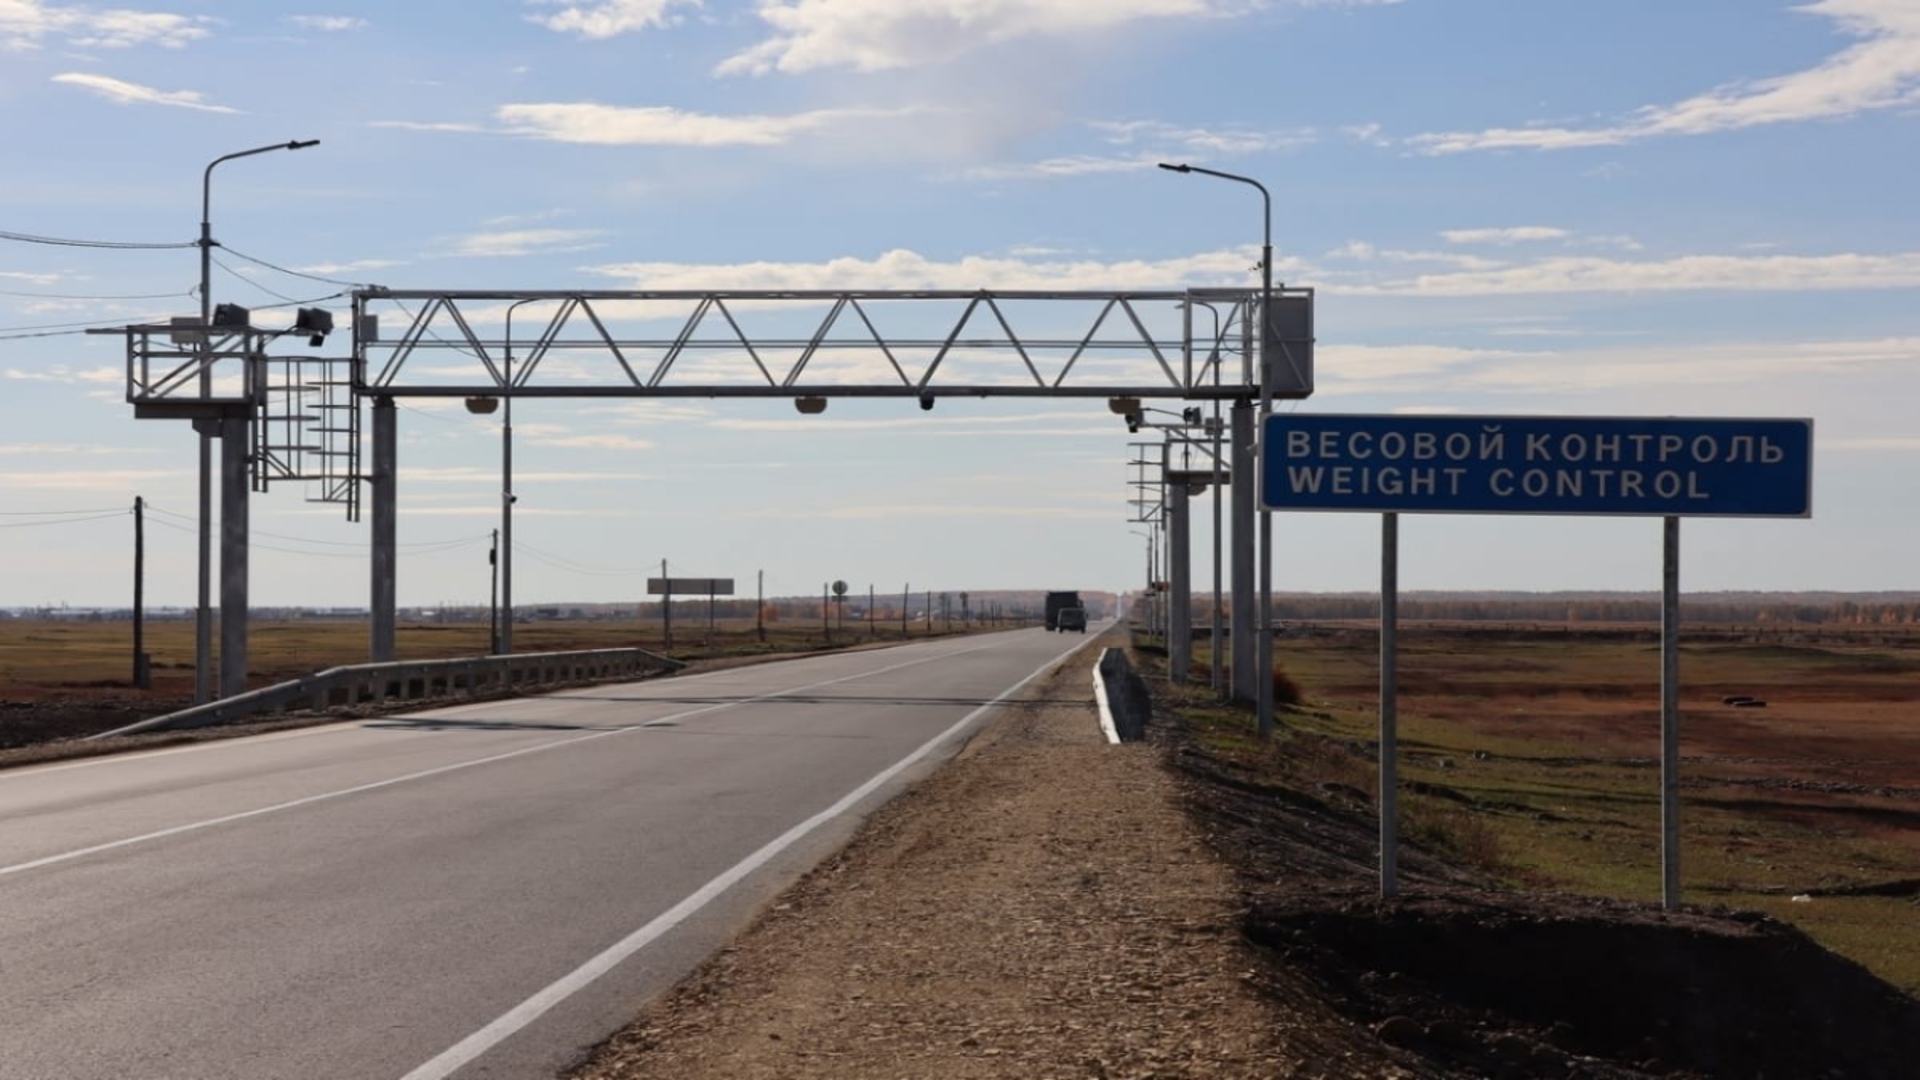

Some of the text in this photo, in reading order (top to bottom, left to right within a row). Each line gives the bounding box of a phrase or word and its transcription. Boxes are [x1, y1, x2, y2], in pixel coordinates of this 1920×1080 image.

[1287, 425, 1784, 463] ВЕСОВОЙ КОНТРОЛЬ
[1288, 466, 1708, 498] WEIGHT CONTROL
